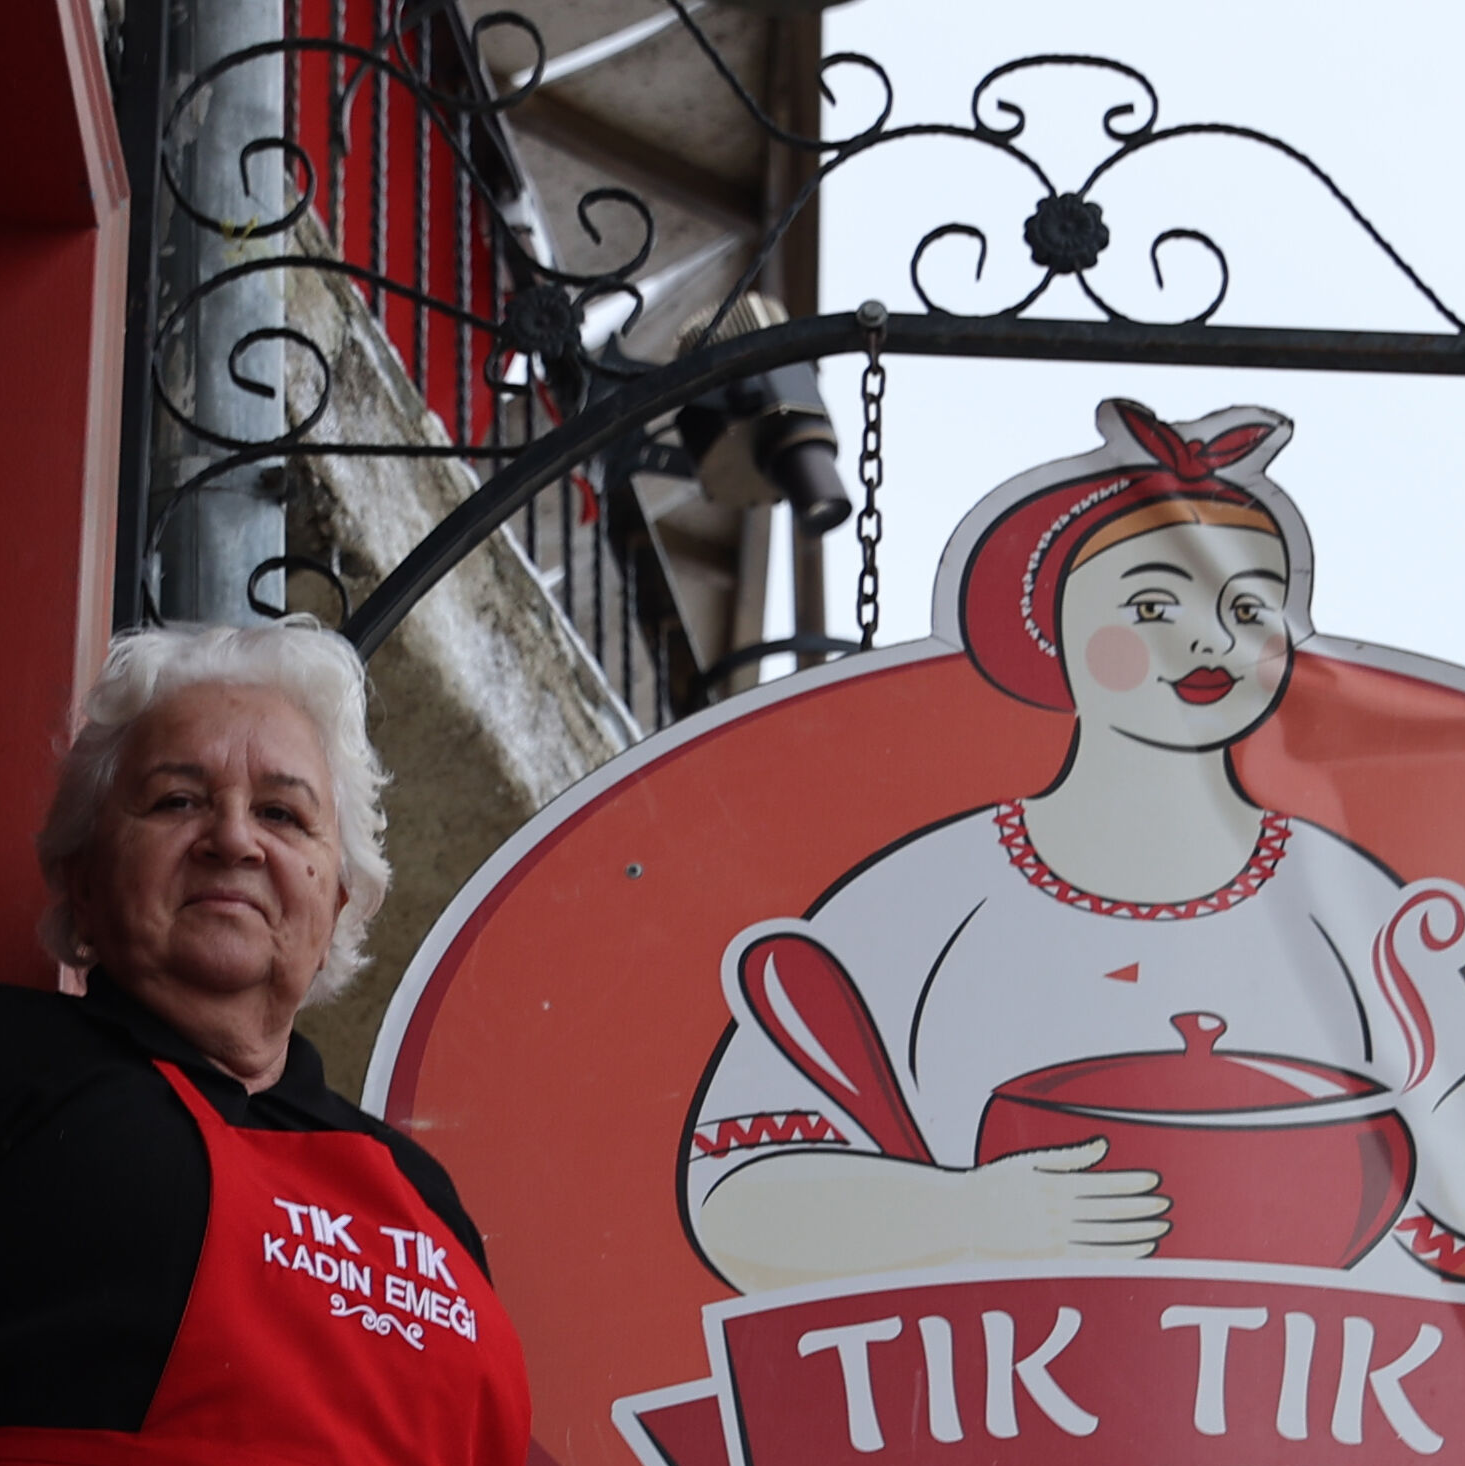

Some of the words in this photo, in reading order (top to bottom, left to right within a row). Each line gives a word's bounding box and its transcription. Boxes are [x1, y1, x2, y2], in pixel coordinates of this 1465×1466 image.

[263, 1232, 371, 1297] KADIN
[274, 1197, 361, 1254] TIK
[379, 1226, 458, 1291] TIK
[797, 1306, 1099, 1453] TIK
[1160, 1305, 1445, 1456] TIK
